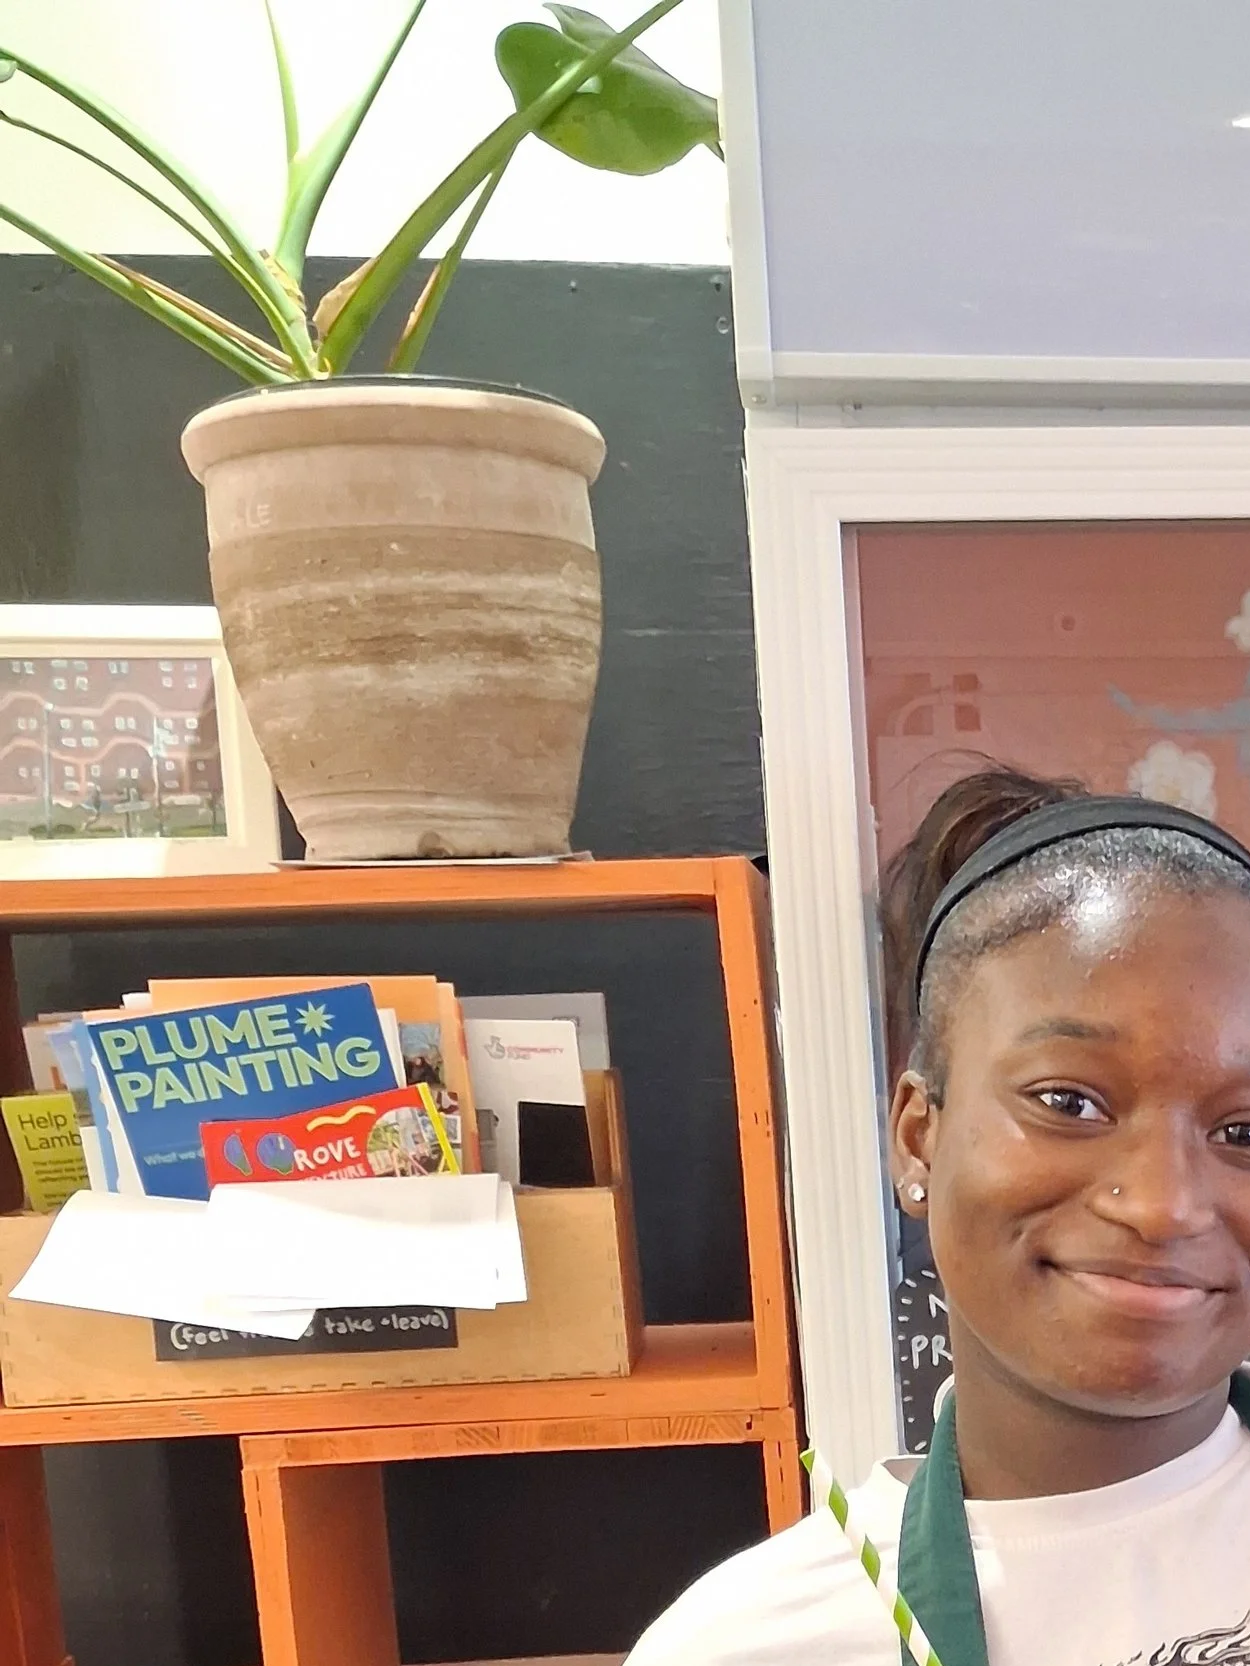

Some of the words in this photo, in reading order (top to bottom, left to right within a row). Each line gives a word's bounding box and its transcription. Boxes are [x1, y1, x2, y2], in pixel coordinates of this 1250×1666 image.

[100, 1003, 297, 1071] PLUME
[114, 1036, 381, 1113] PAINTING
[17, 1111, 68, 1132] Help
